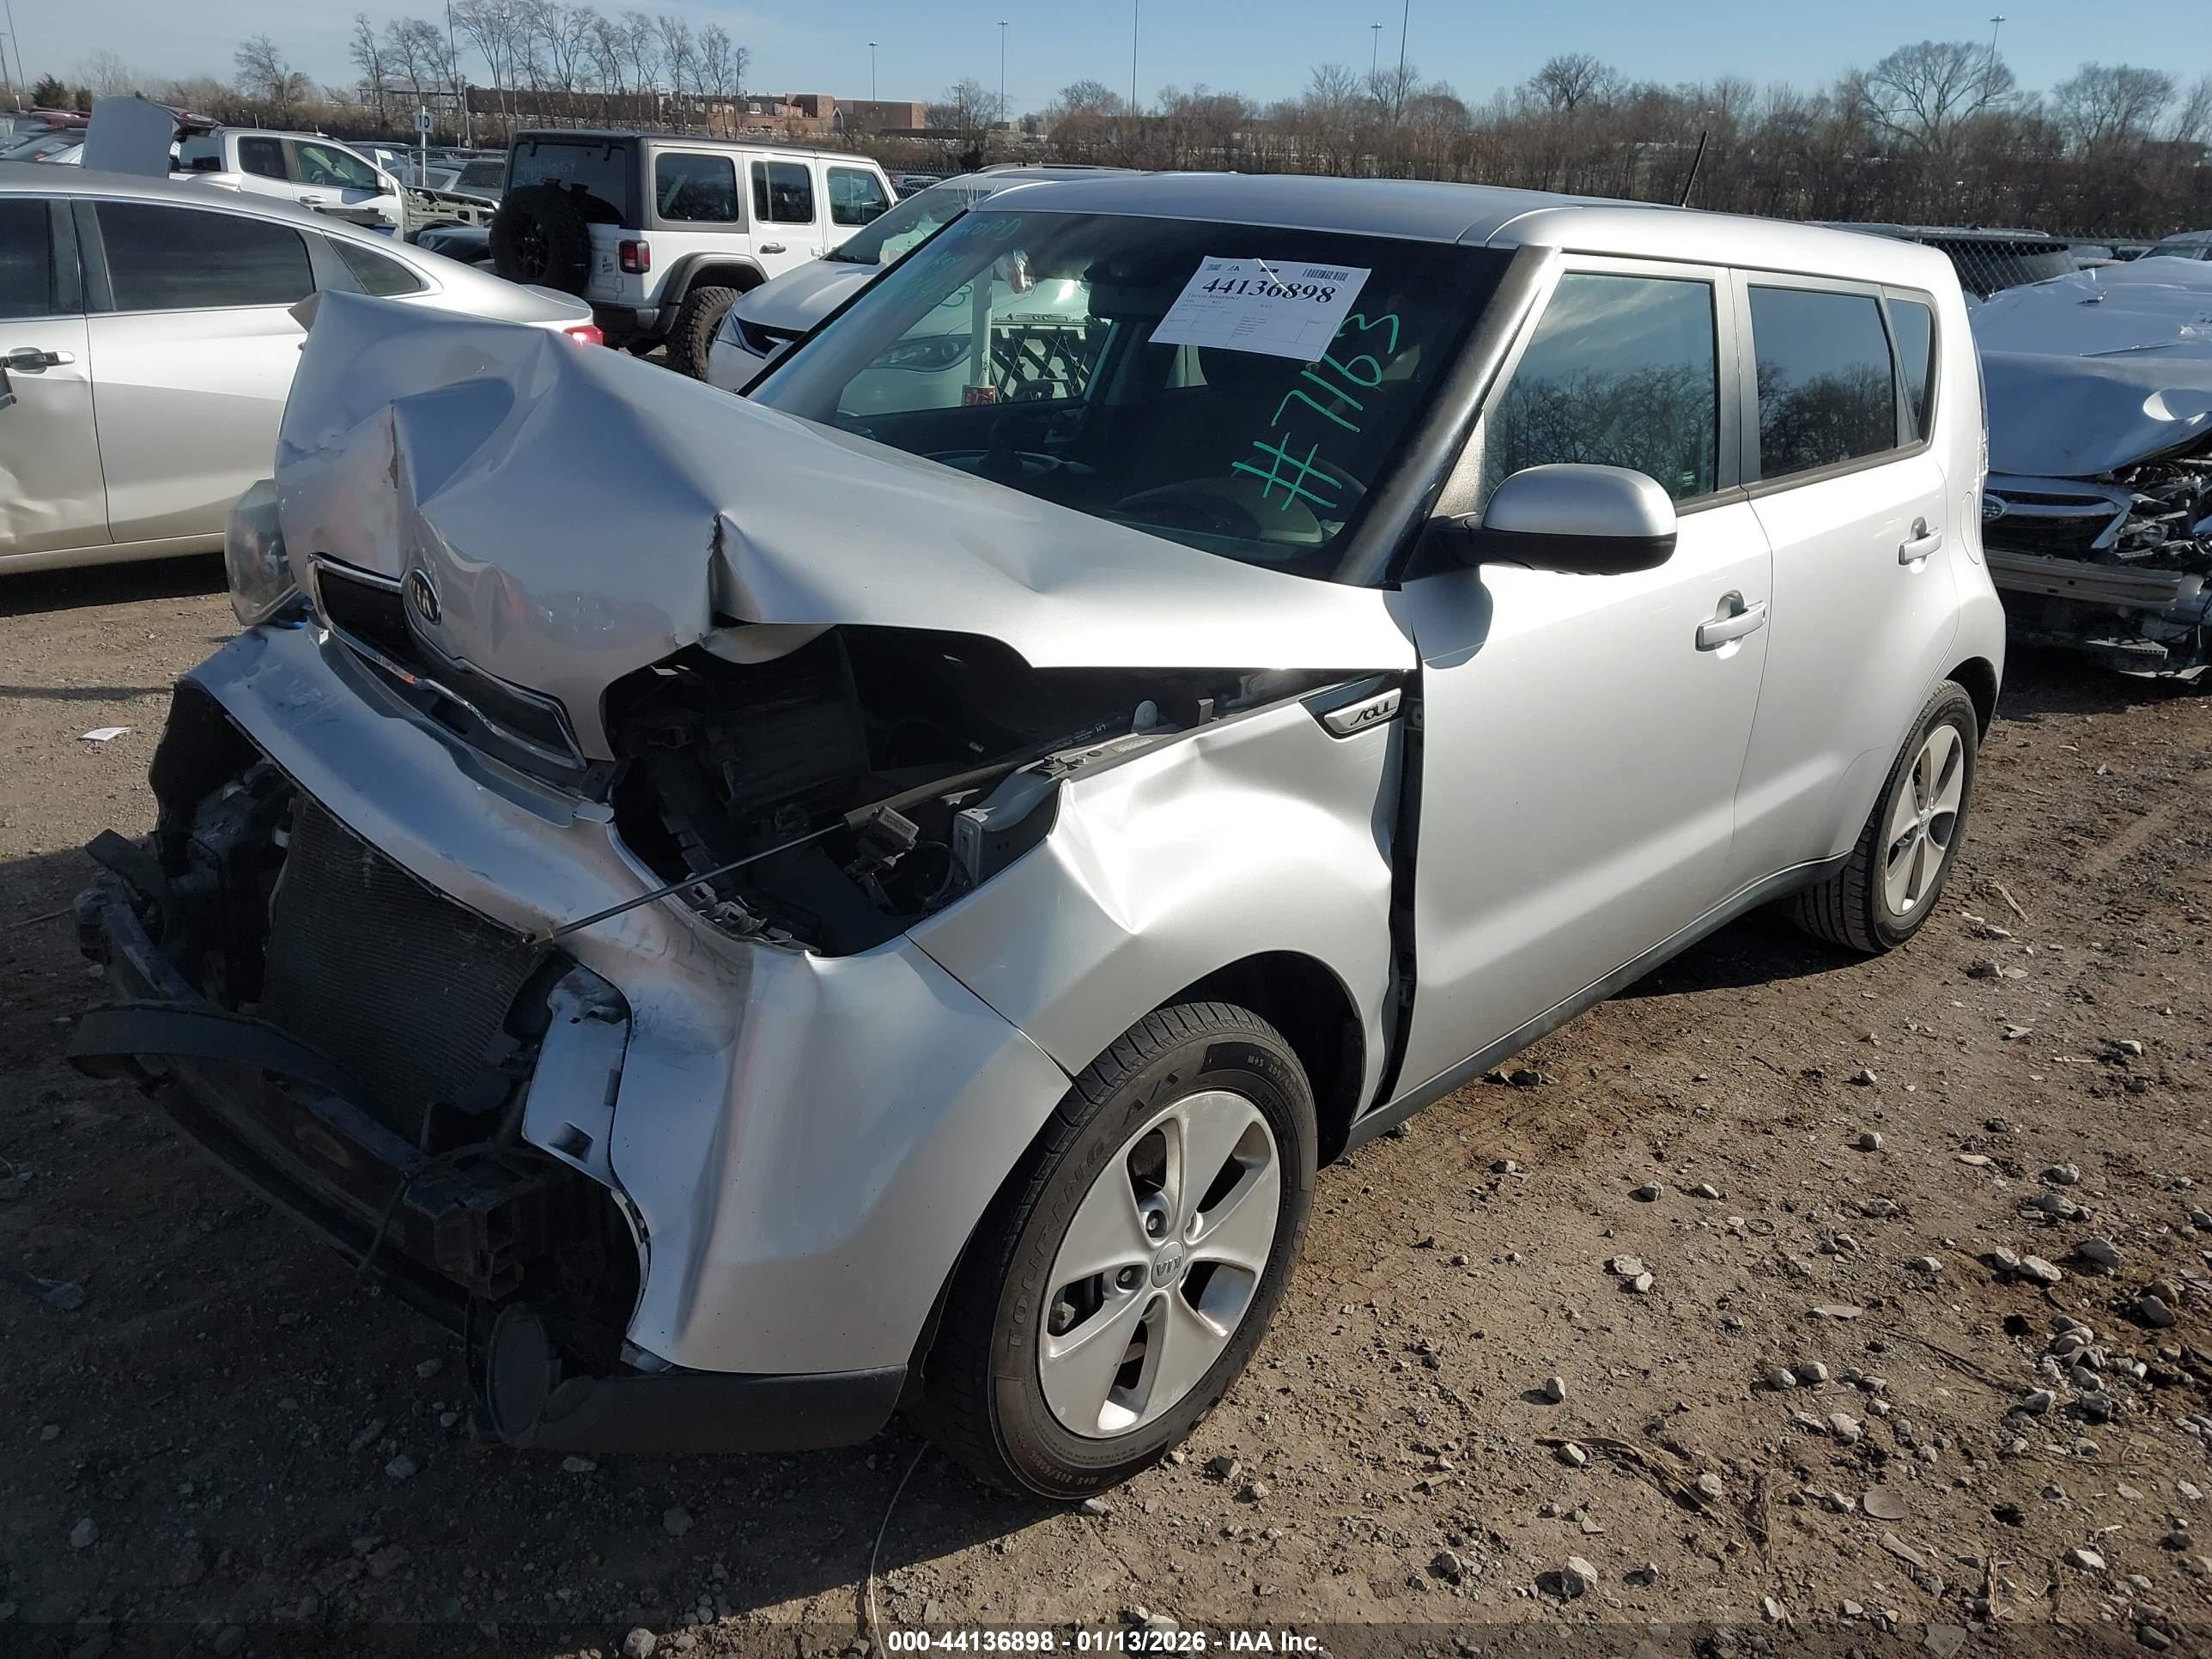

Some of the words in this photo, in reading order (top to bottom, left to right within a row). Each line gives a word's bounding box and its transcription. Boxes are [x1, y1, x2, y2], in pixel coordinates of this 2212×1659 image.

[418, 114, 430, 129] 10
[1201, 277, 1336, 303] 44136898
[1006, 1136, 1106, 1352] TOURING
[1156, 1254, 1182, 1277] KIA
